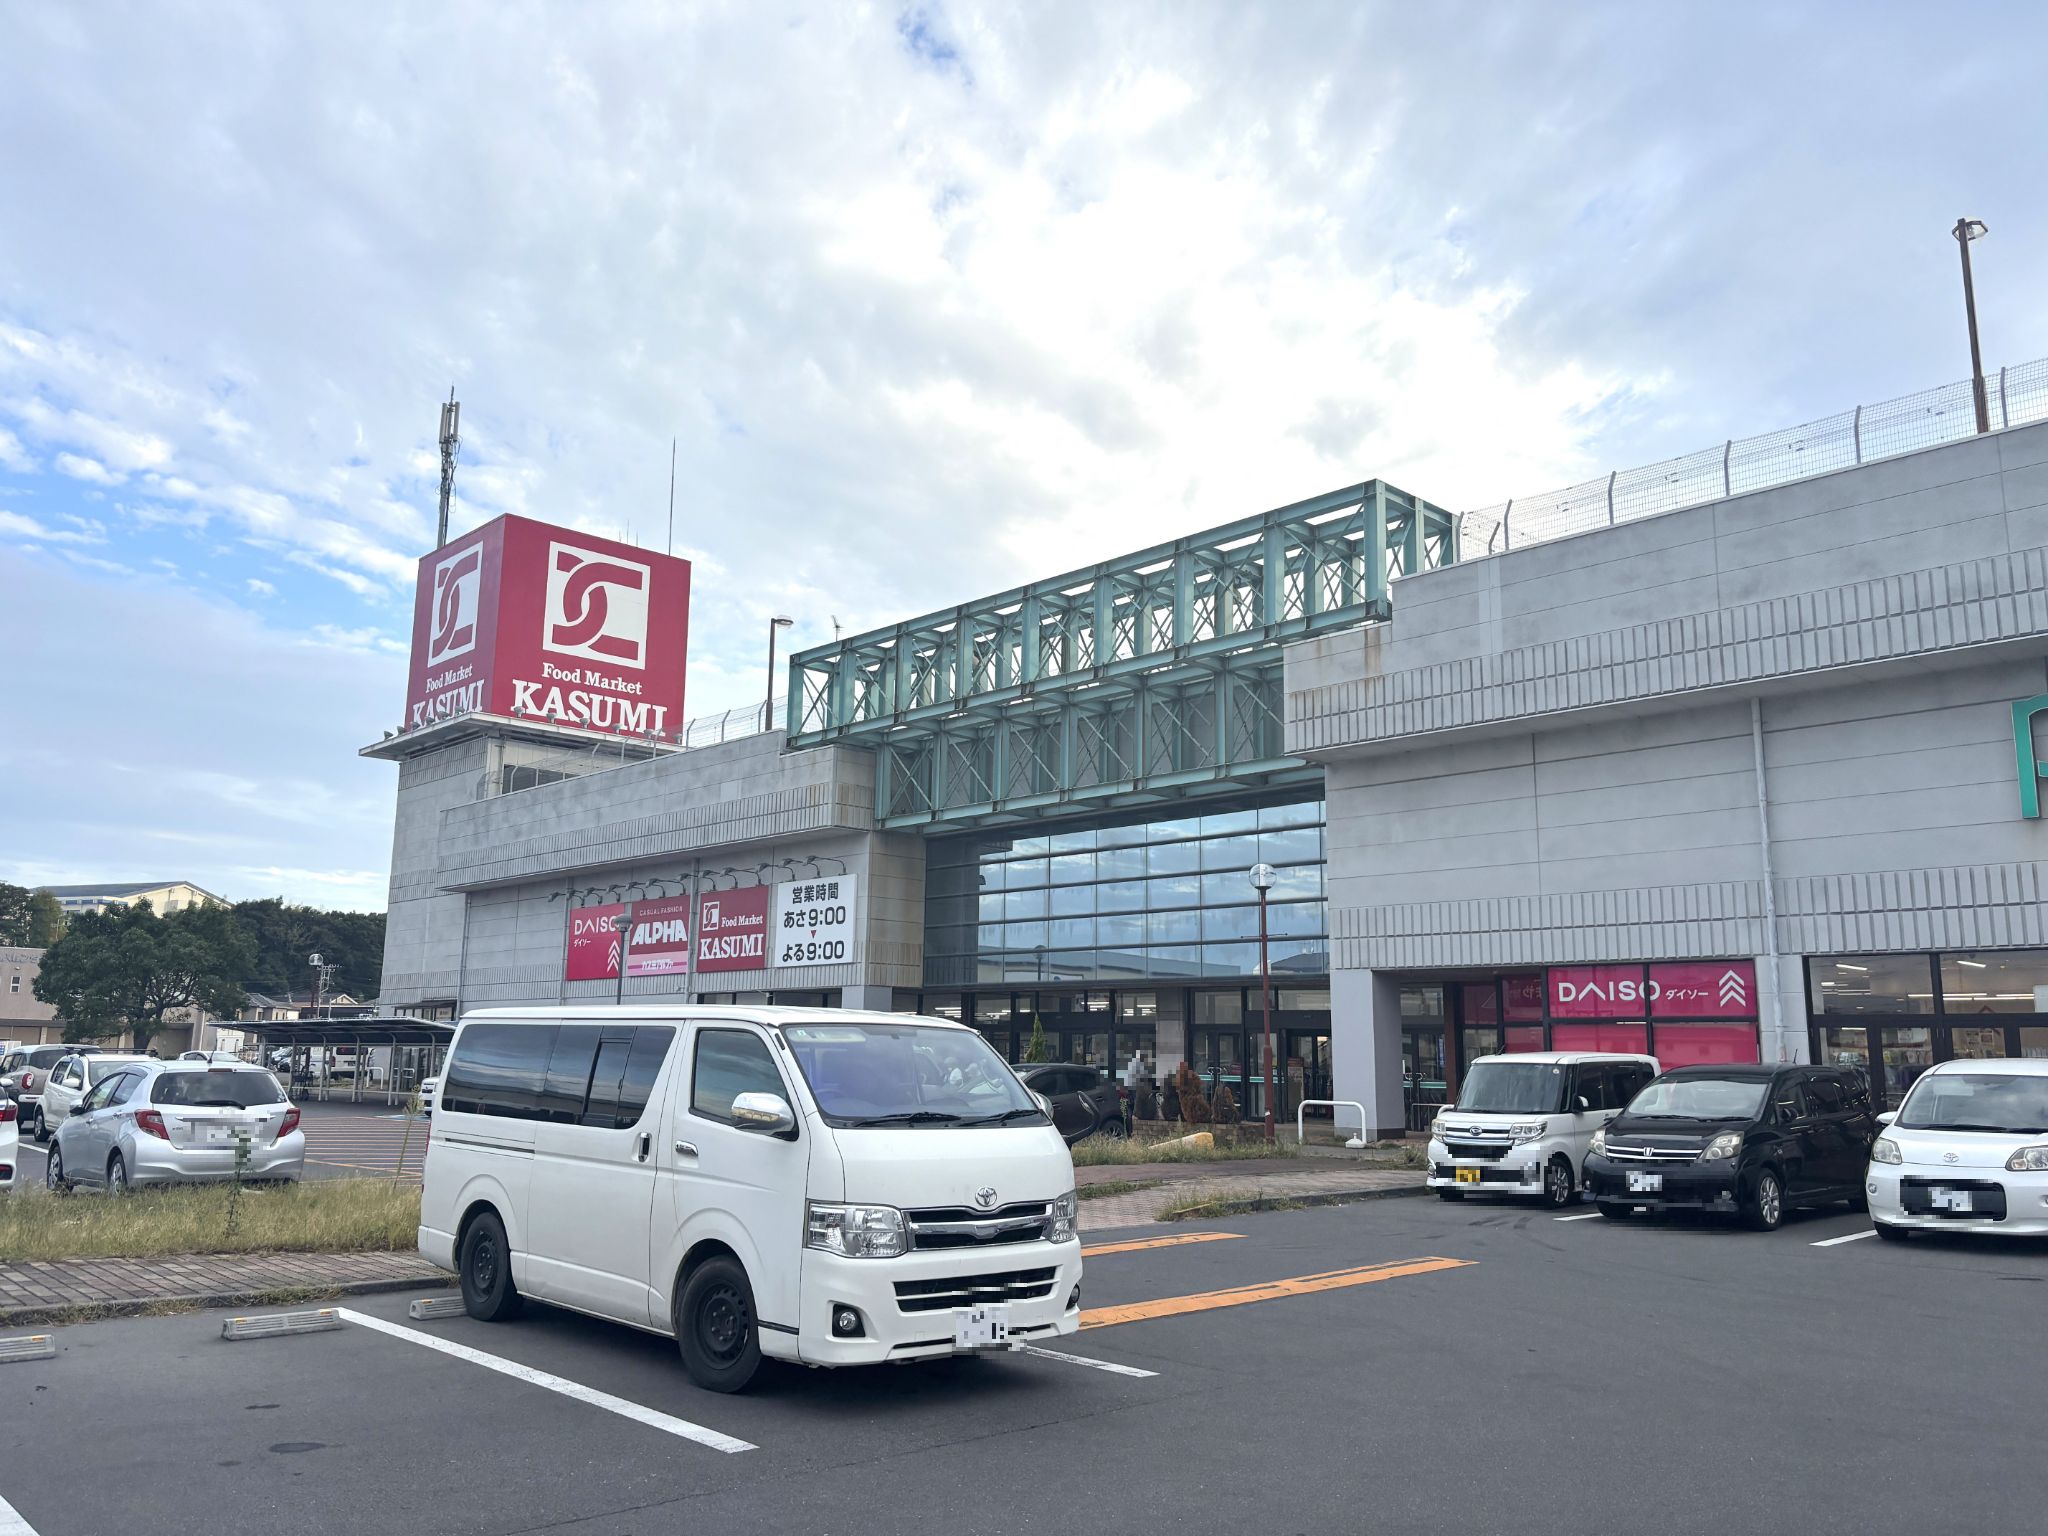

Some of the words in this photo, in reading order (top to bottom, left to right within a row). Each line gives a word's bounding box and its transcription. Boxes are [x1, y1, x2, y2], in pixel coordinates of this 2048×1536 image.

[426, 674, 444, 693] Food
[444, 664, 473, 686] Market
[542, 662, 581, 684] Food
[584, 670, 643, 695] Market
[412, 679, 485, 729] KASUMI
[511, 679, 668, 737] KASUMI
[792, 882, 839, 904] 営業時間
[639, 908, 660, 917] CASUAL
[660, 905, 683, 915] FASHION
[721, 915, 738, 928] Food
[738, 913, 764, 926] Market
[573, 938, 592, 948] ダイソー
[631, 919, 688, 946] ALPHA
[699, 933, 764, 960] KASUMI
[1558, 980, 1661, 1002] DAISO
[1665, 988, 1710, 1001] ダイソー
